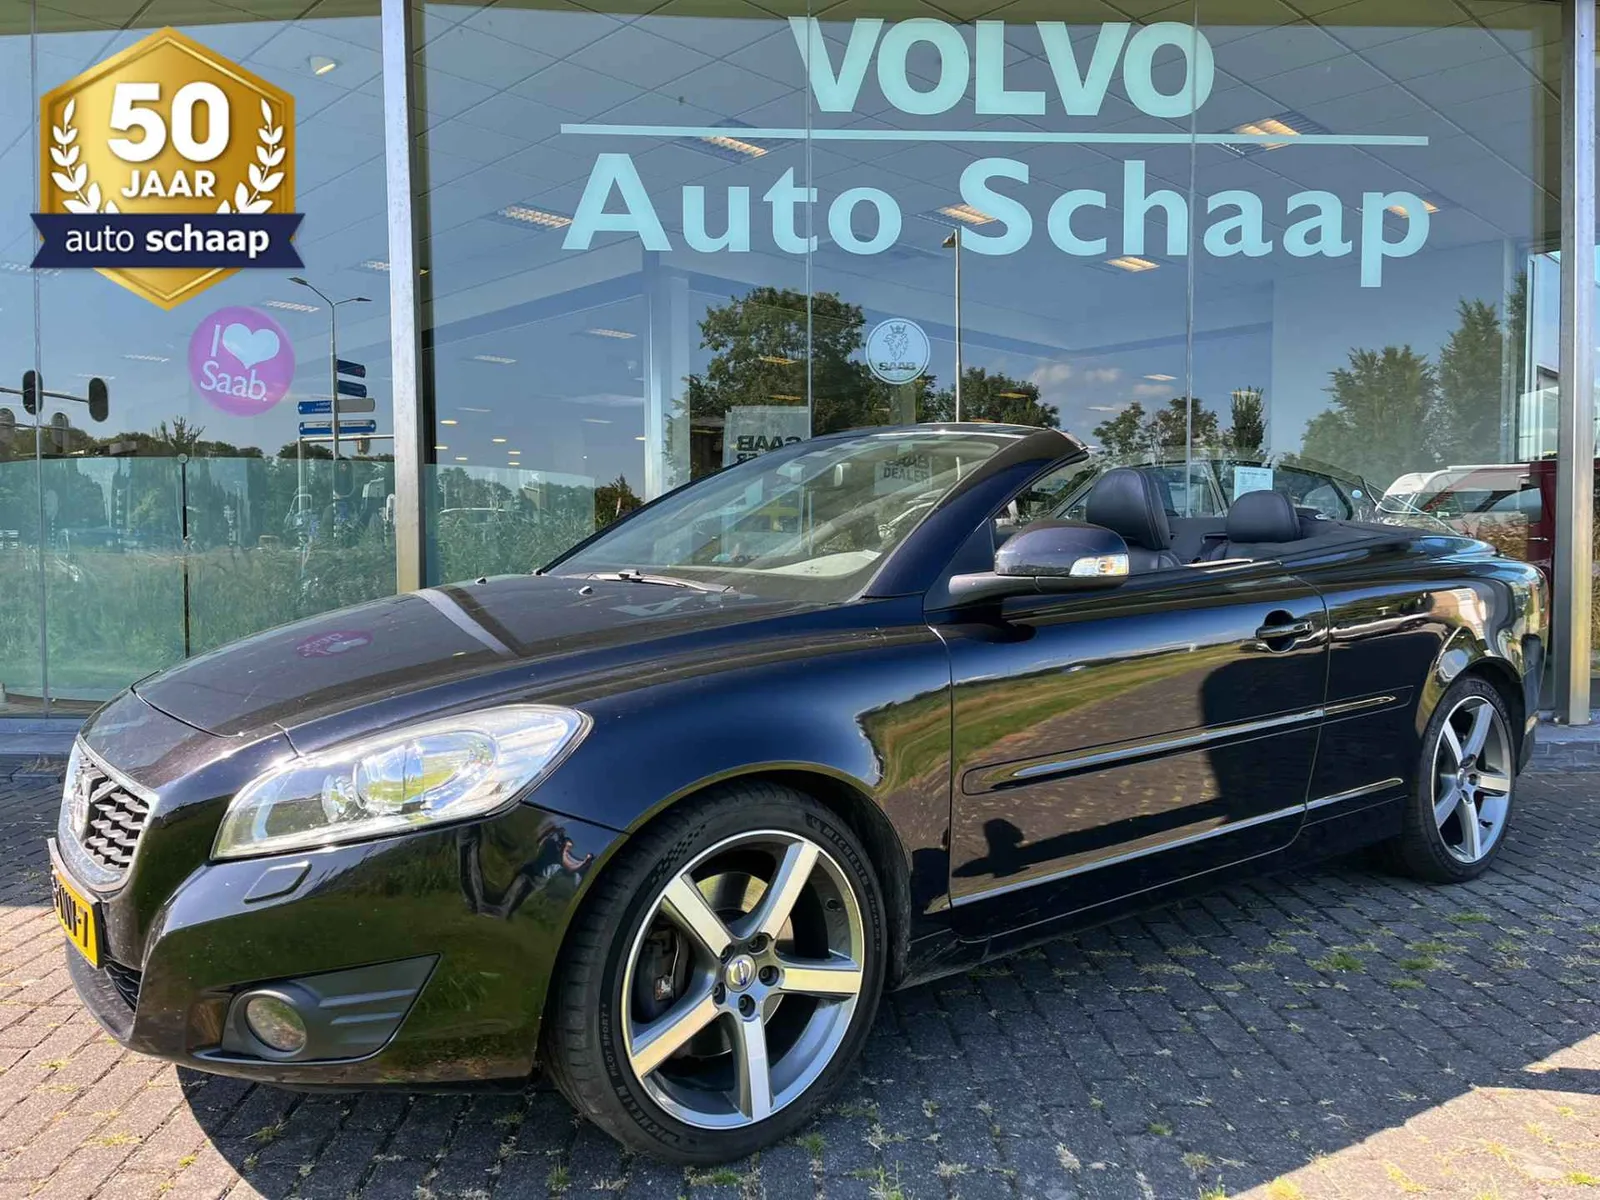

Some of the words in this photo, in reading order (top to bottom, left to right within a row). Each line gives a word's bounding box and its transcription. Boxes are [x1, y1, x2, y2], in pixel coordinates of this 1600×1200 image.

[788, 16, 1215, 118] VOLVO
[562, 152, 903, 256] Auto
[959, 157, 1430, 288] Schaap
[210, 323, 221, 357] I
[878, 361, 917, 371] SAAB
